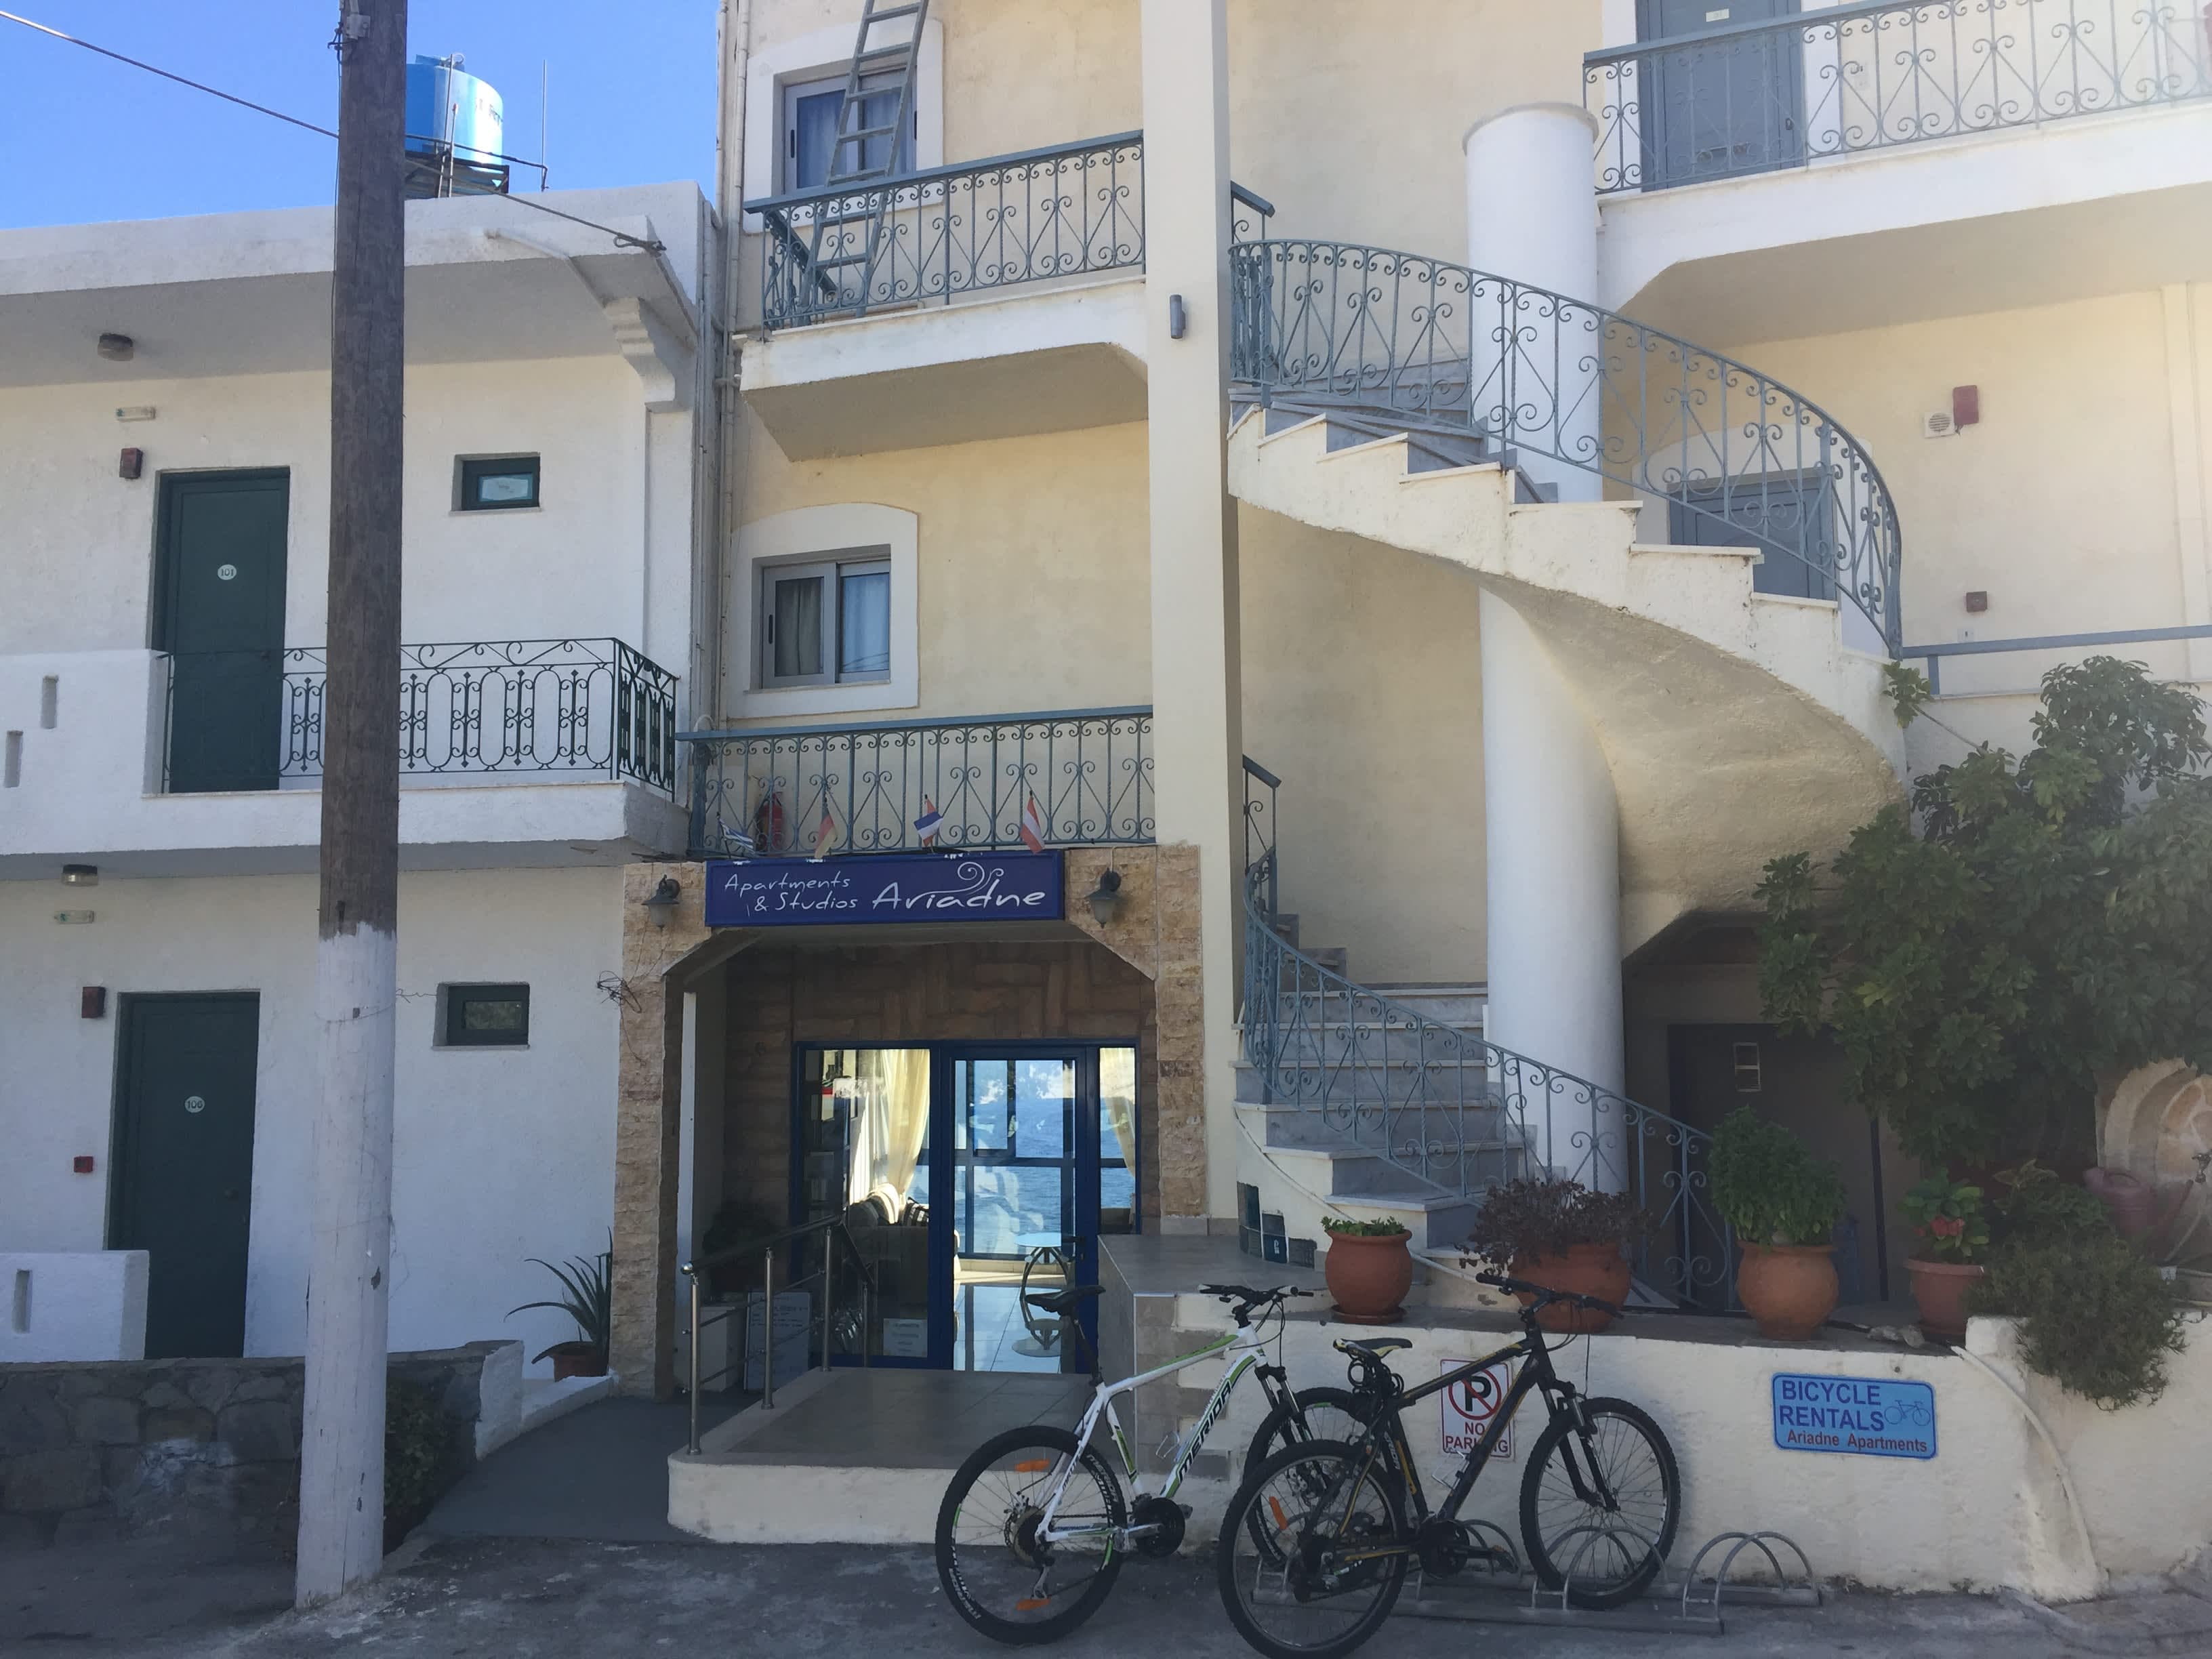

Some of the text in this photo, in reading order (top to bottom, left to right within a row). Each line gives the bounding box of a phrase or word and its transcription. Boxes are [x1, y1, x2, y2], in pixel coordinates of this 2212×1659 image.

[221, 569, 234, 577] 101
[724, 870, 851, 897] Apartments
[872, 879, 1046, 910] Ariadne
[754, 890, 859, 912] & Studios
[1782, 1380, 1881, 1406] BICYCLE
[1465, 1422, 1486, 1435] NO
[1779, 1405, 1885, 1431] RENTALS
[1179, 1380, 1231, 1483] MERIDA
[1445, 1435, 1509, 1452] PARG
[1787, 1429, 1927, 1452] Ariadne Apartments
